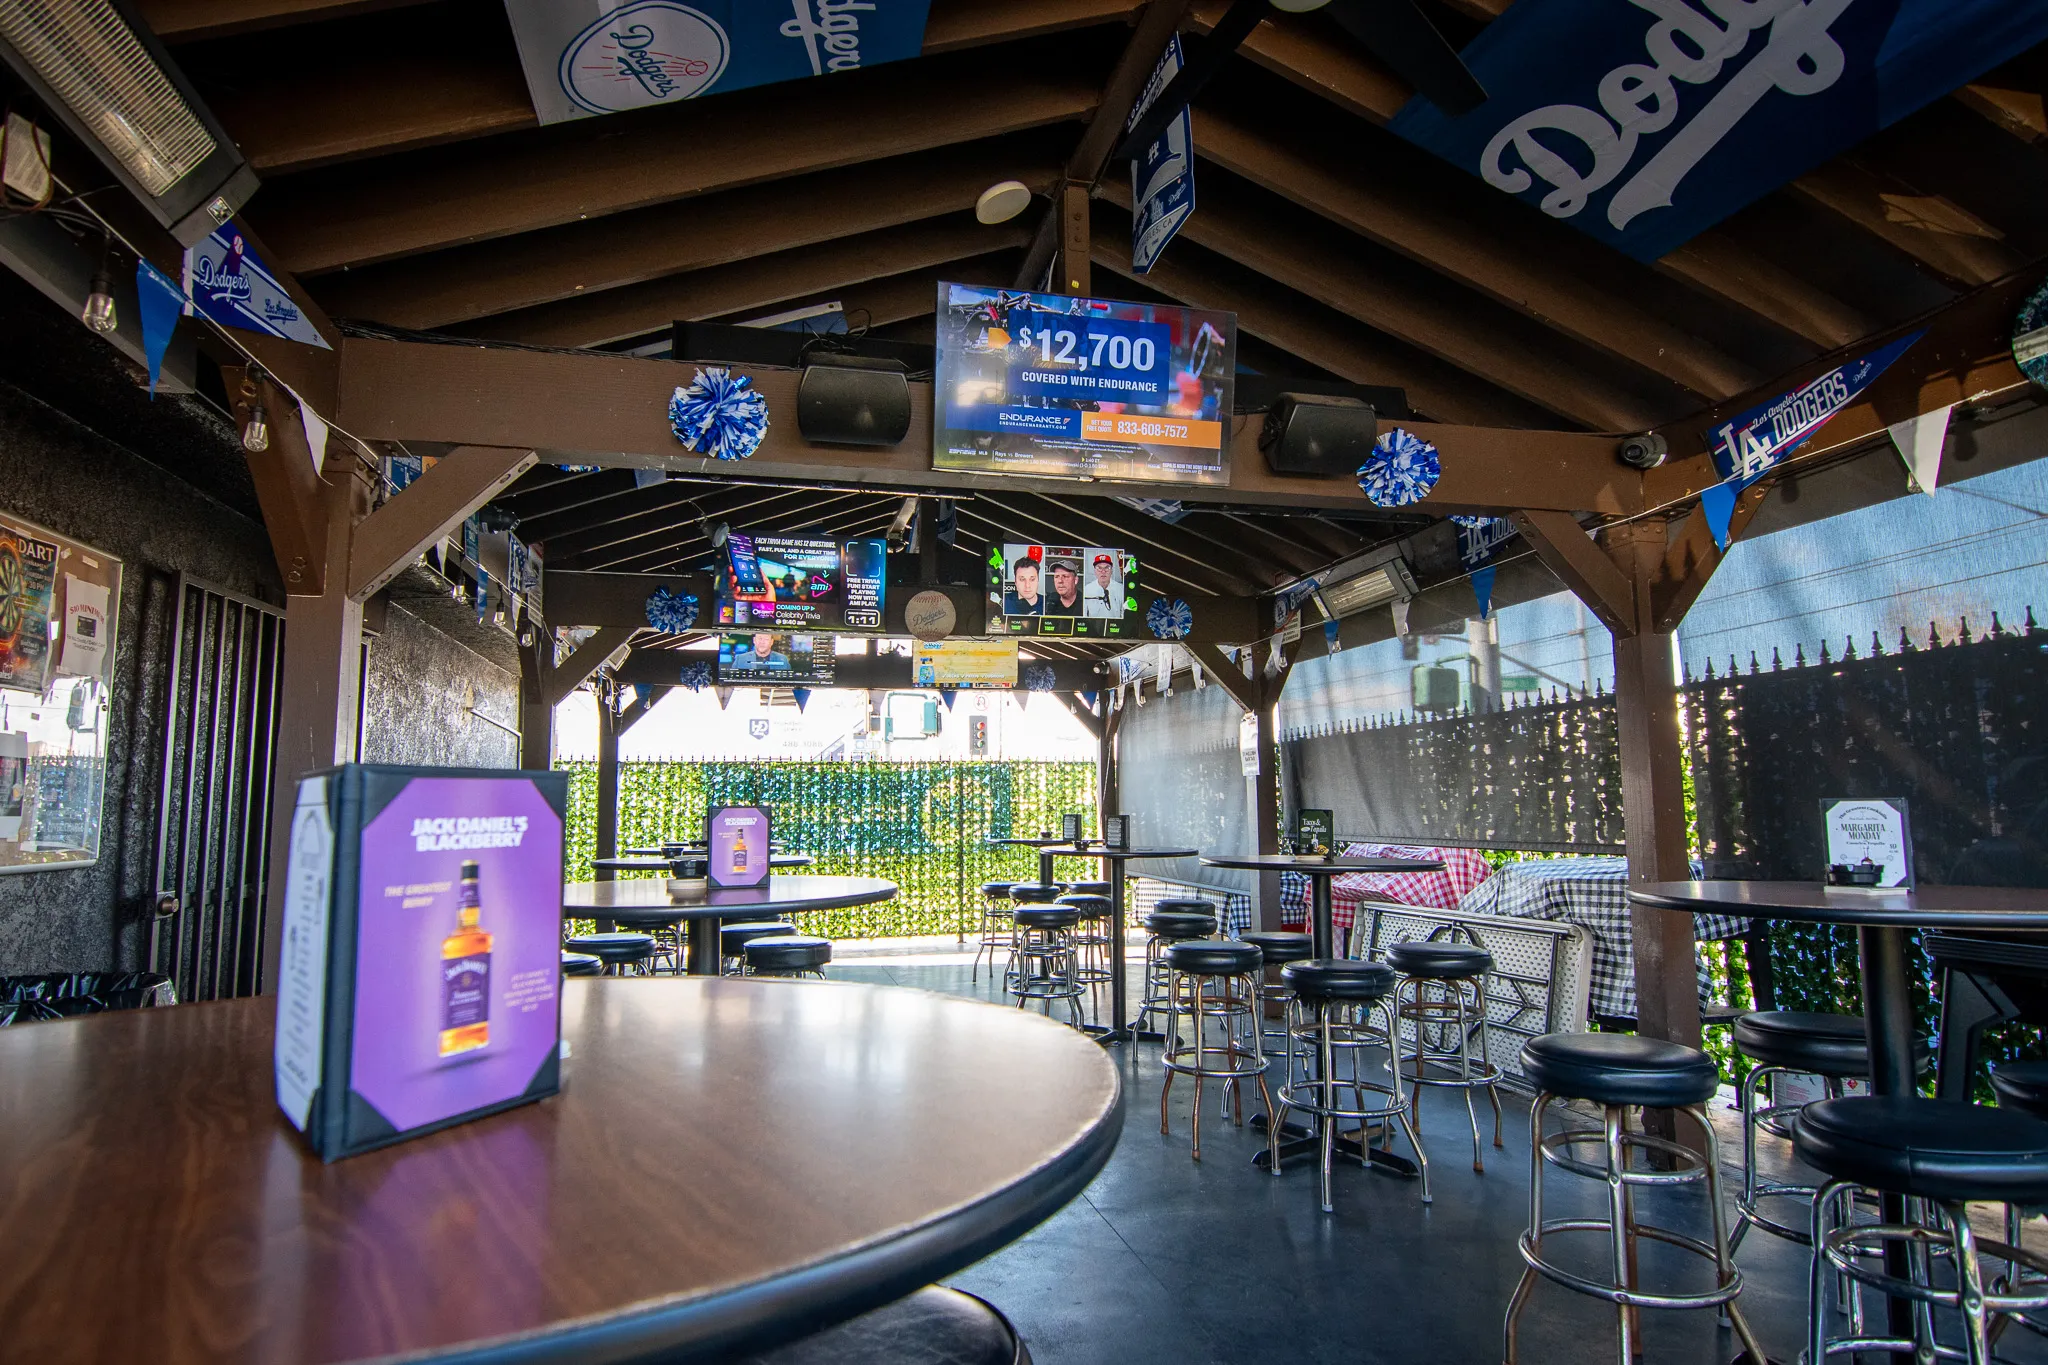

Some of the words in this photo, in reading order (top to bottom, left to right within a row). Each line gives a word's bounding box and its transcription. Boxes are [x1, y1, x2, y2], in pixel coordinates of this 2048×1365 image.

[609, 24, 681, 98] Dodgers
[200, 257, 252, 302] Dodgers
[1022, 371, 1068, 386] COVERED
[1071, 375, 1096, 388] WITH
[1098, 378, 1158, 393] ENDURANCE
[1753, 413, 1767, 427] Los
[1768, 392, 1800, 417] Angeles
[1772, 372, 1848, 441] DODGERS
[999, 413, 1061, 425] ENDURANCE
[1117, 421, 1189, 439] 833-608-7572
[1719, 422, 1775, 480] LA
[18, 538, 54, 562] DART
[781, 538, 794, 546] GAME
[810, 581, 829, 591] ami
[775, 610, 804, 620] Celebrity
[804, 612, 821, 620] Trivia
[847, 616, 876, 624] 1:11
[912, 608, 947, 627] Dodgers
[410, 817, 456, 837] JACK
[457, 816, 529, 833] DANIEL'S
[1840, 823, 1886, 832] MARGARITA
[1848, 831, 1881, 840] MONDAY
[415, 831, 524, 852] BLACKBERRY
